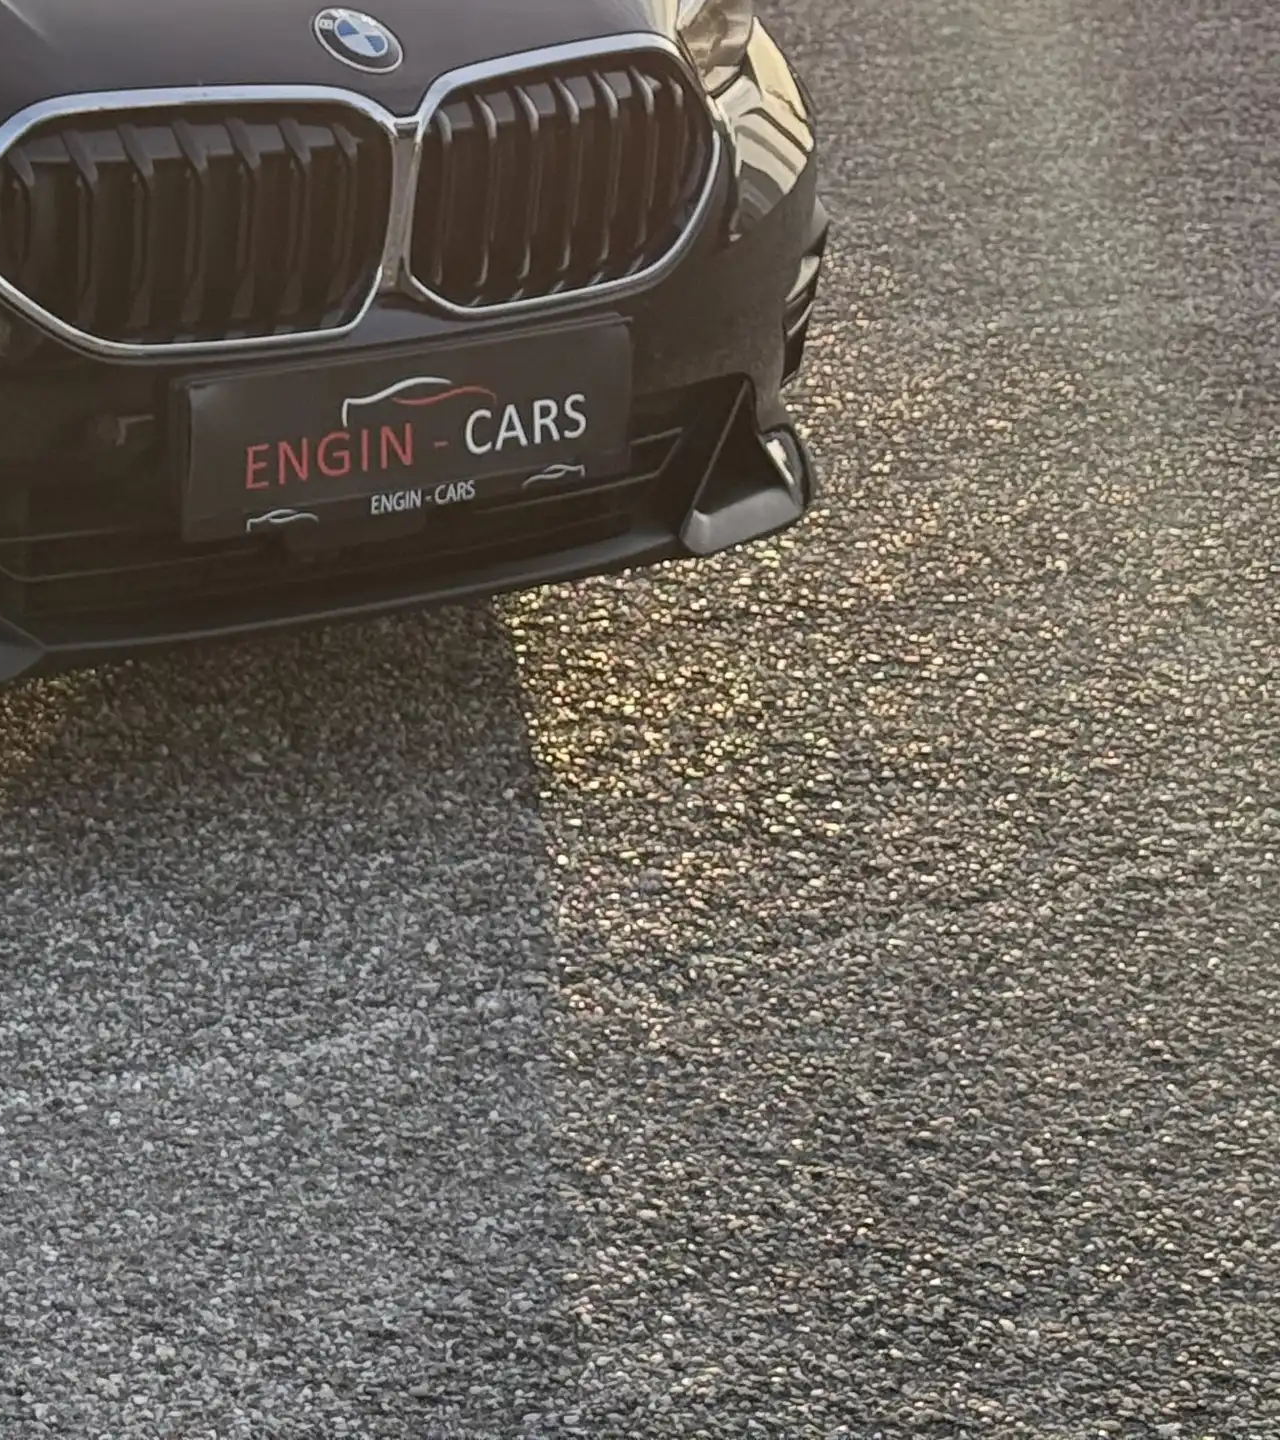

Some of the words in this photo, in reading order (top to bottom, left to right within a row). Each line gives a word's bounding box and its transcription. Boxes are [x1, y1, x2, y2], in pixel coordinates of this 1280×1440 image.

[245, 422, 415, 490] ENGIN
[465, 394, 588, 456] CARS
[370, 489, 422, 515] ENGIN
[434, 481, 476, 508] CARS
